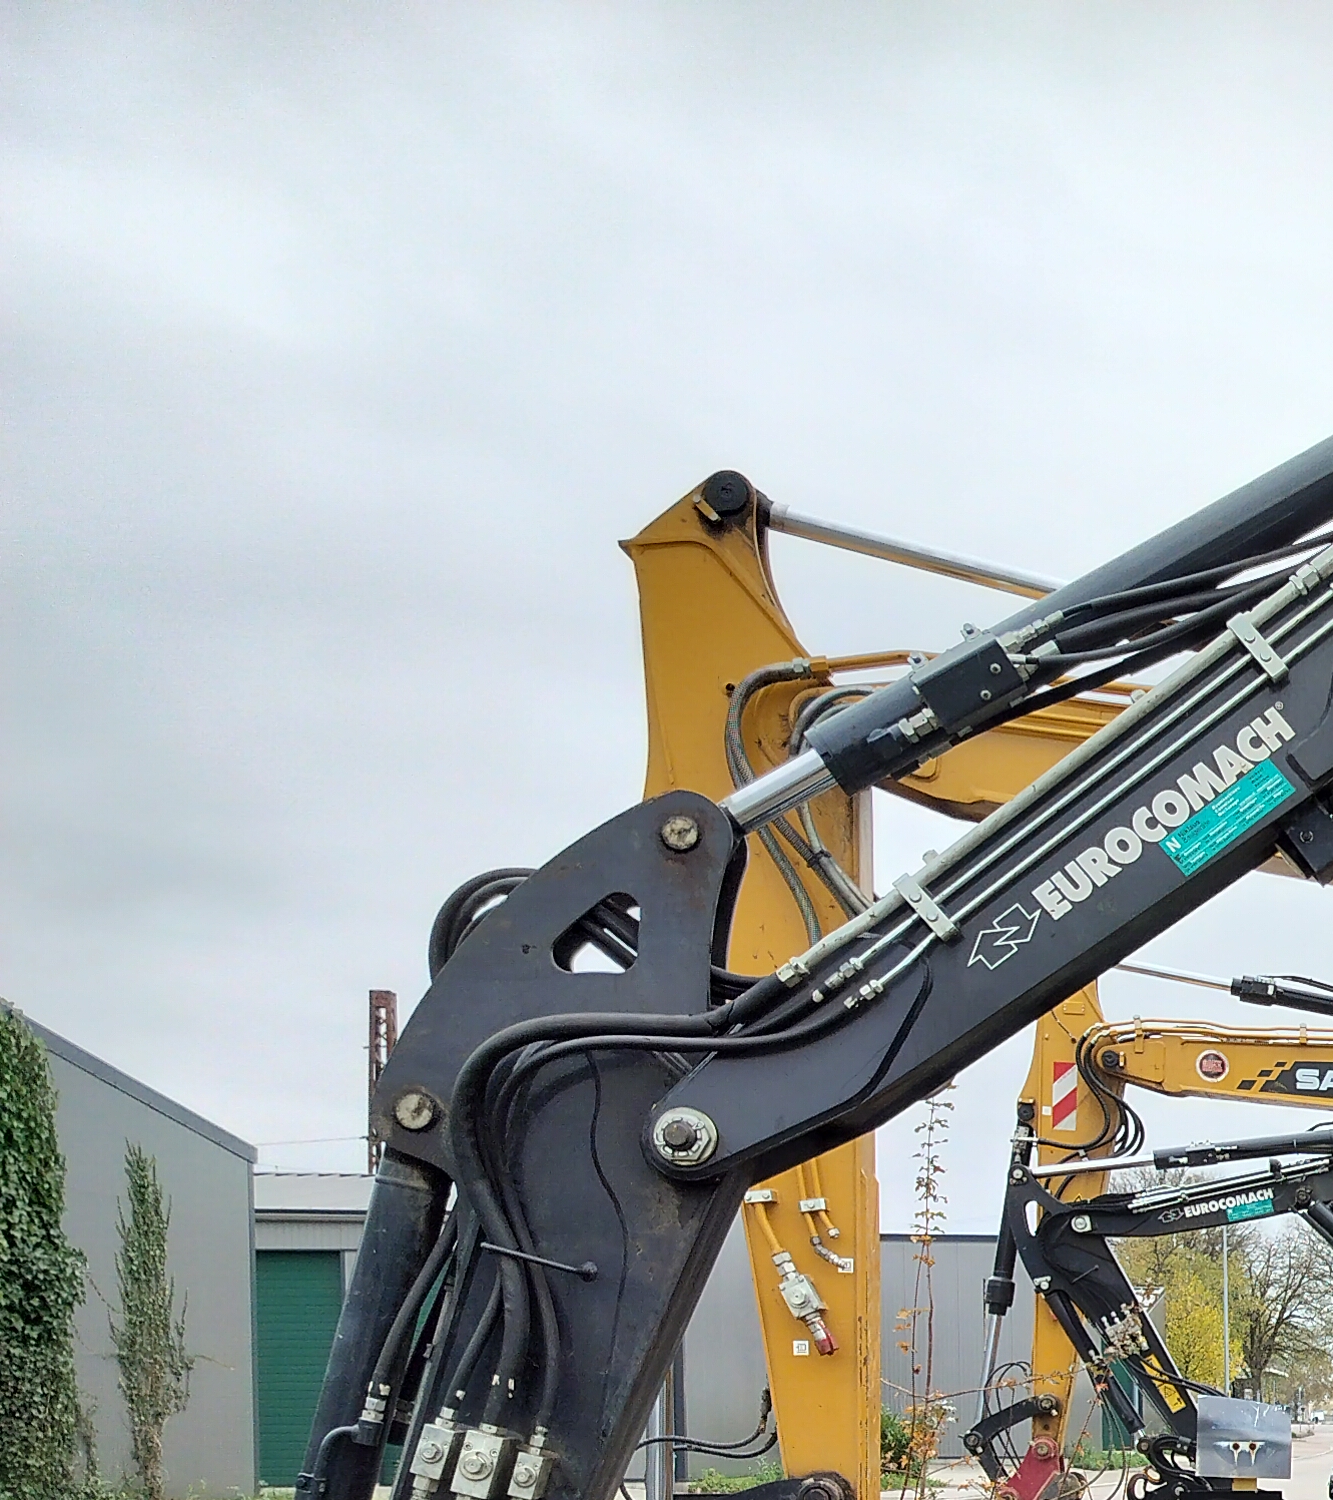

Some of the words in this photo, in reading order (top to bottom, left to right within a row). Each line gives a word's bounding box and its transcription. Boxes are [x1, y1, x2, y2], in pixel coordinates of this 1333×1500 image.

[1031, 705, 1297, 921] EUROCOMACH
[1165, 837, 1181, 853] N
[1183, 1187, 1274, 1218] EUROCOMACH
